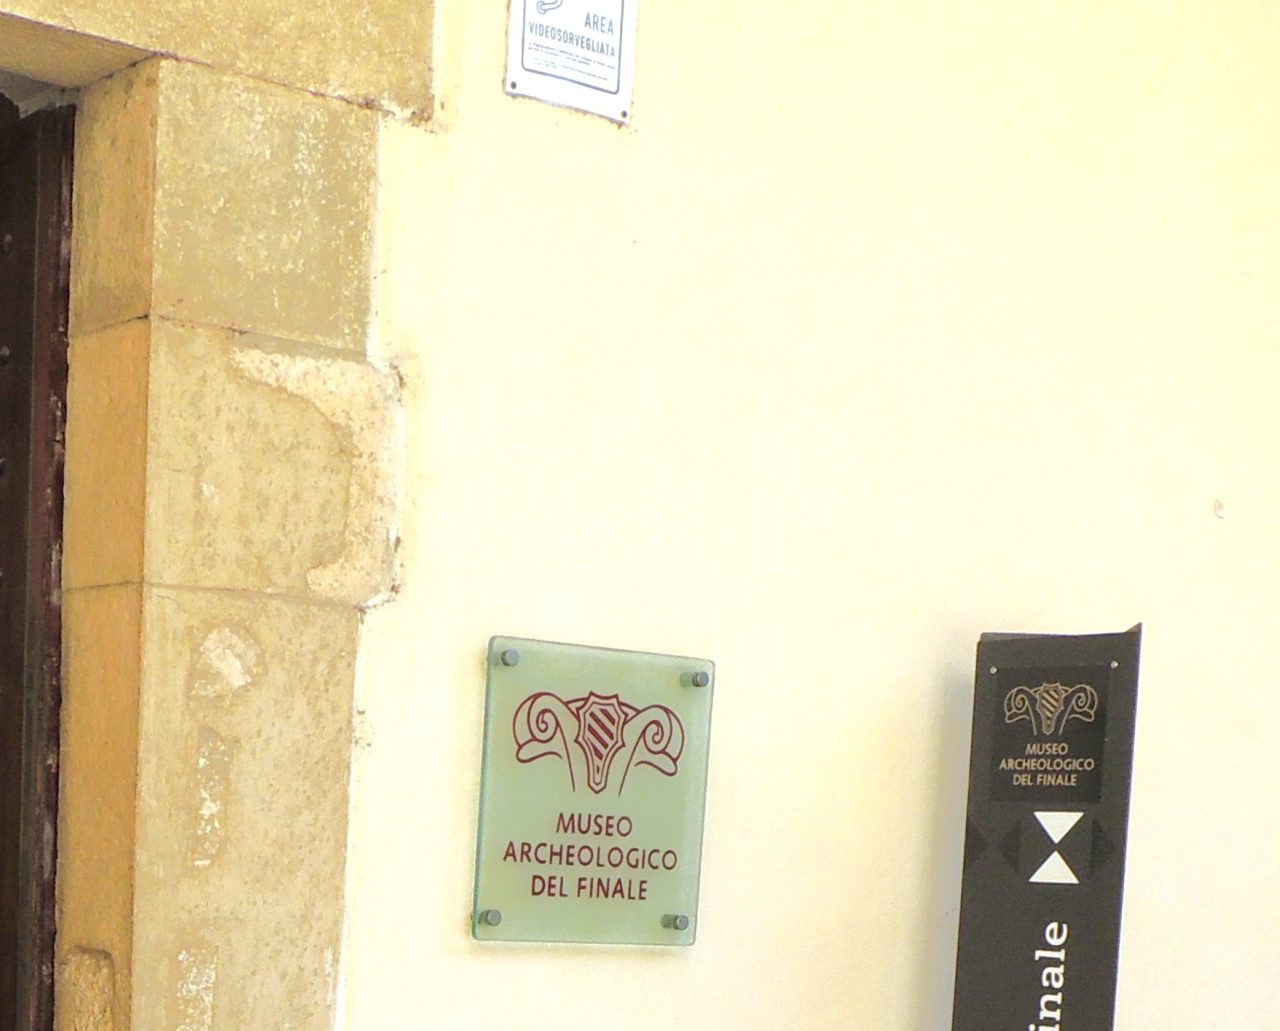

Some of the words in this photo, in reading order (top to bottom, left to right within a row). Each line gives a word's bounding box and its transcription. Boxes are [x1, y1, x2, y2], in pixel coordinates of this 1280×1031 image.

[584, 13, 614, 35] AREA
[528, 21, 615, 57] VIDEOSORVEGLIATA
[1025, 743, 1069, 755] MUSEO
[998, 758, 1095, 771] ARCHEOLOGICO
[1013, 774, 1034, 786] DEL
[1036, 774, 1078, 786] FINALE
[556, 812, 633, 837] MUSEO
[503, 841, 678, 871] ARCHEOLOGICO
[531, 875, 568, 898] DEL
[577, 877, 648, 901] FINALE
